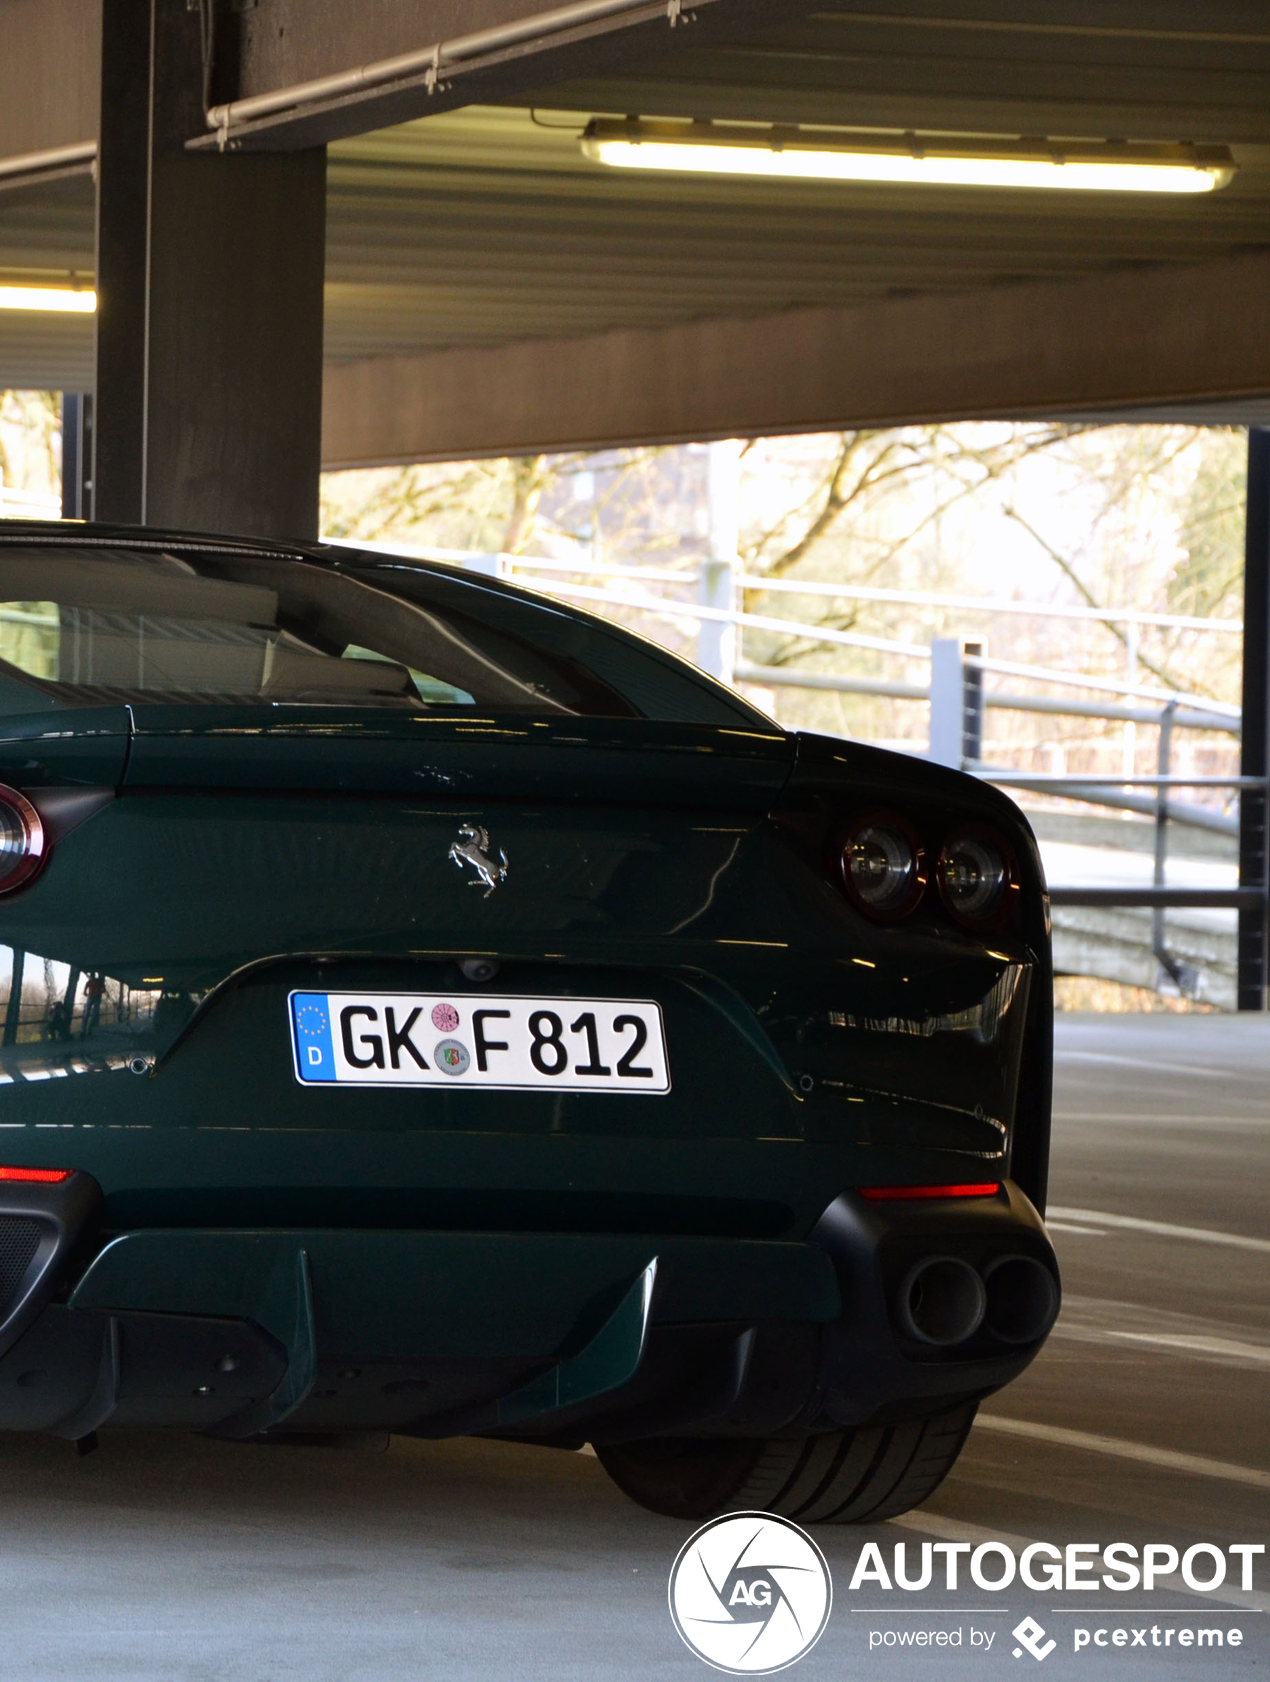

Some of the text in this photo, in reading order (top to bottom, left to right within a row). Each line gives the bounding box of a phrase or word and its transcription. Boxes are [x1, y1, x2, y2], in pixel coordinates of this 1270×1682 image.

[308, 1045, 323, 1066] D
[339, 1005, 430, 1070] GK
[472, 1009, 511, 1072] F
[528, 1010, 654, 1078] 812
